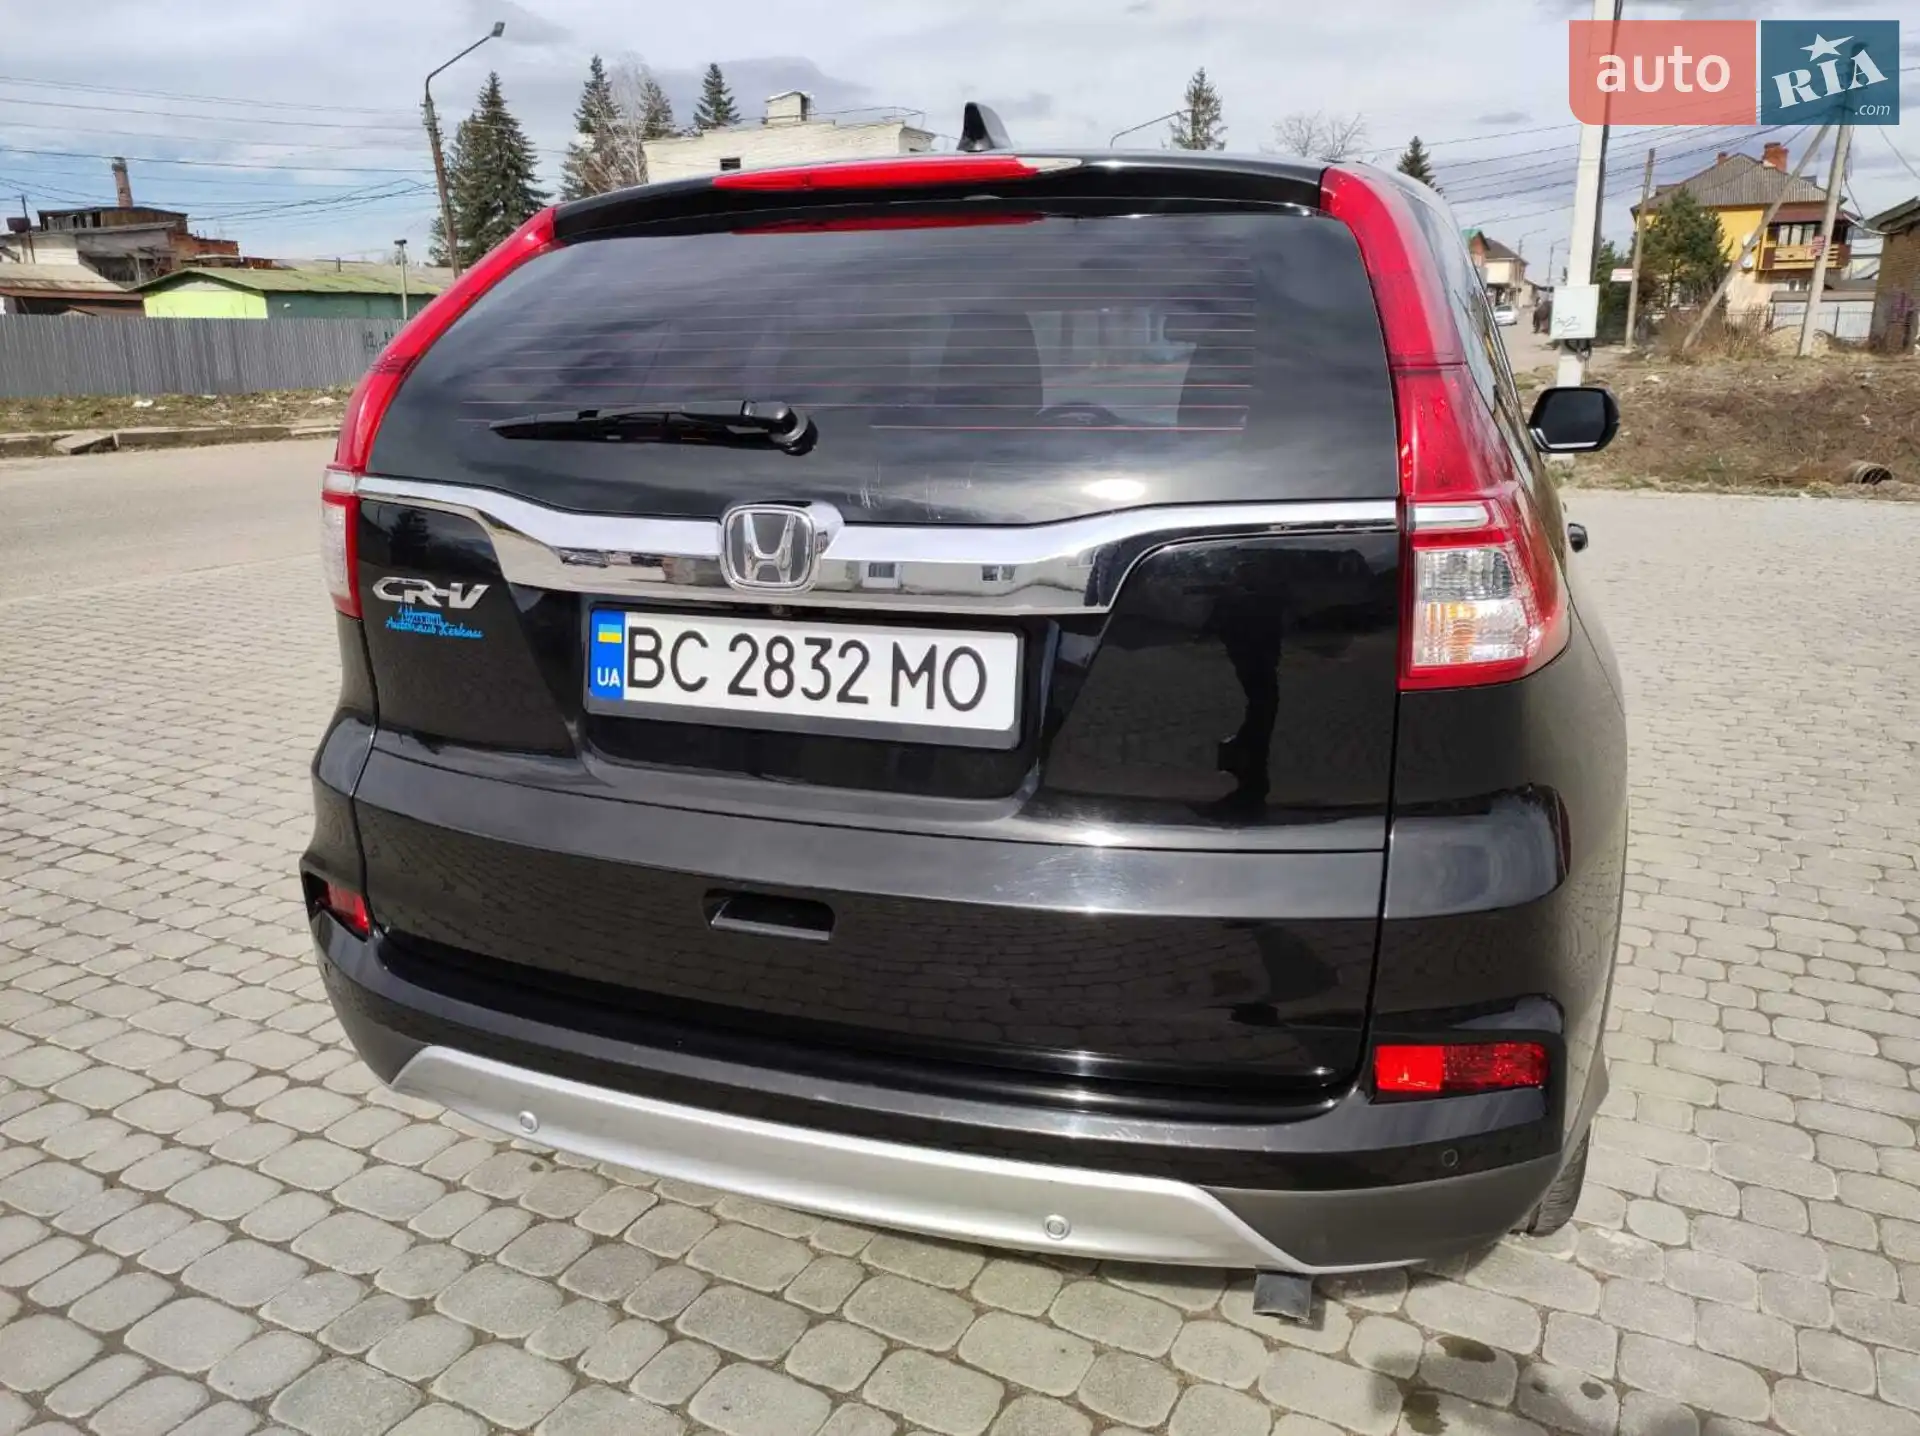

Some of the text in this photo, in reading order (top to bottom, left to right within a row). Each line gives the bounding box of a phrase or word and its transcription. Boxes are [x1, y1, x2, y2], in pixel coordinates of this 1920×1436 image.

[372, 576, 491, 609] CR-V
[597, 666, 621, 687] UA
[627, 625, 988, 713] BC 2832 MO
